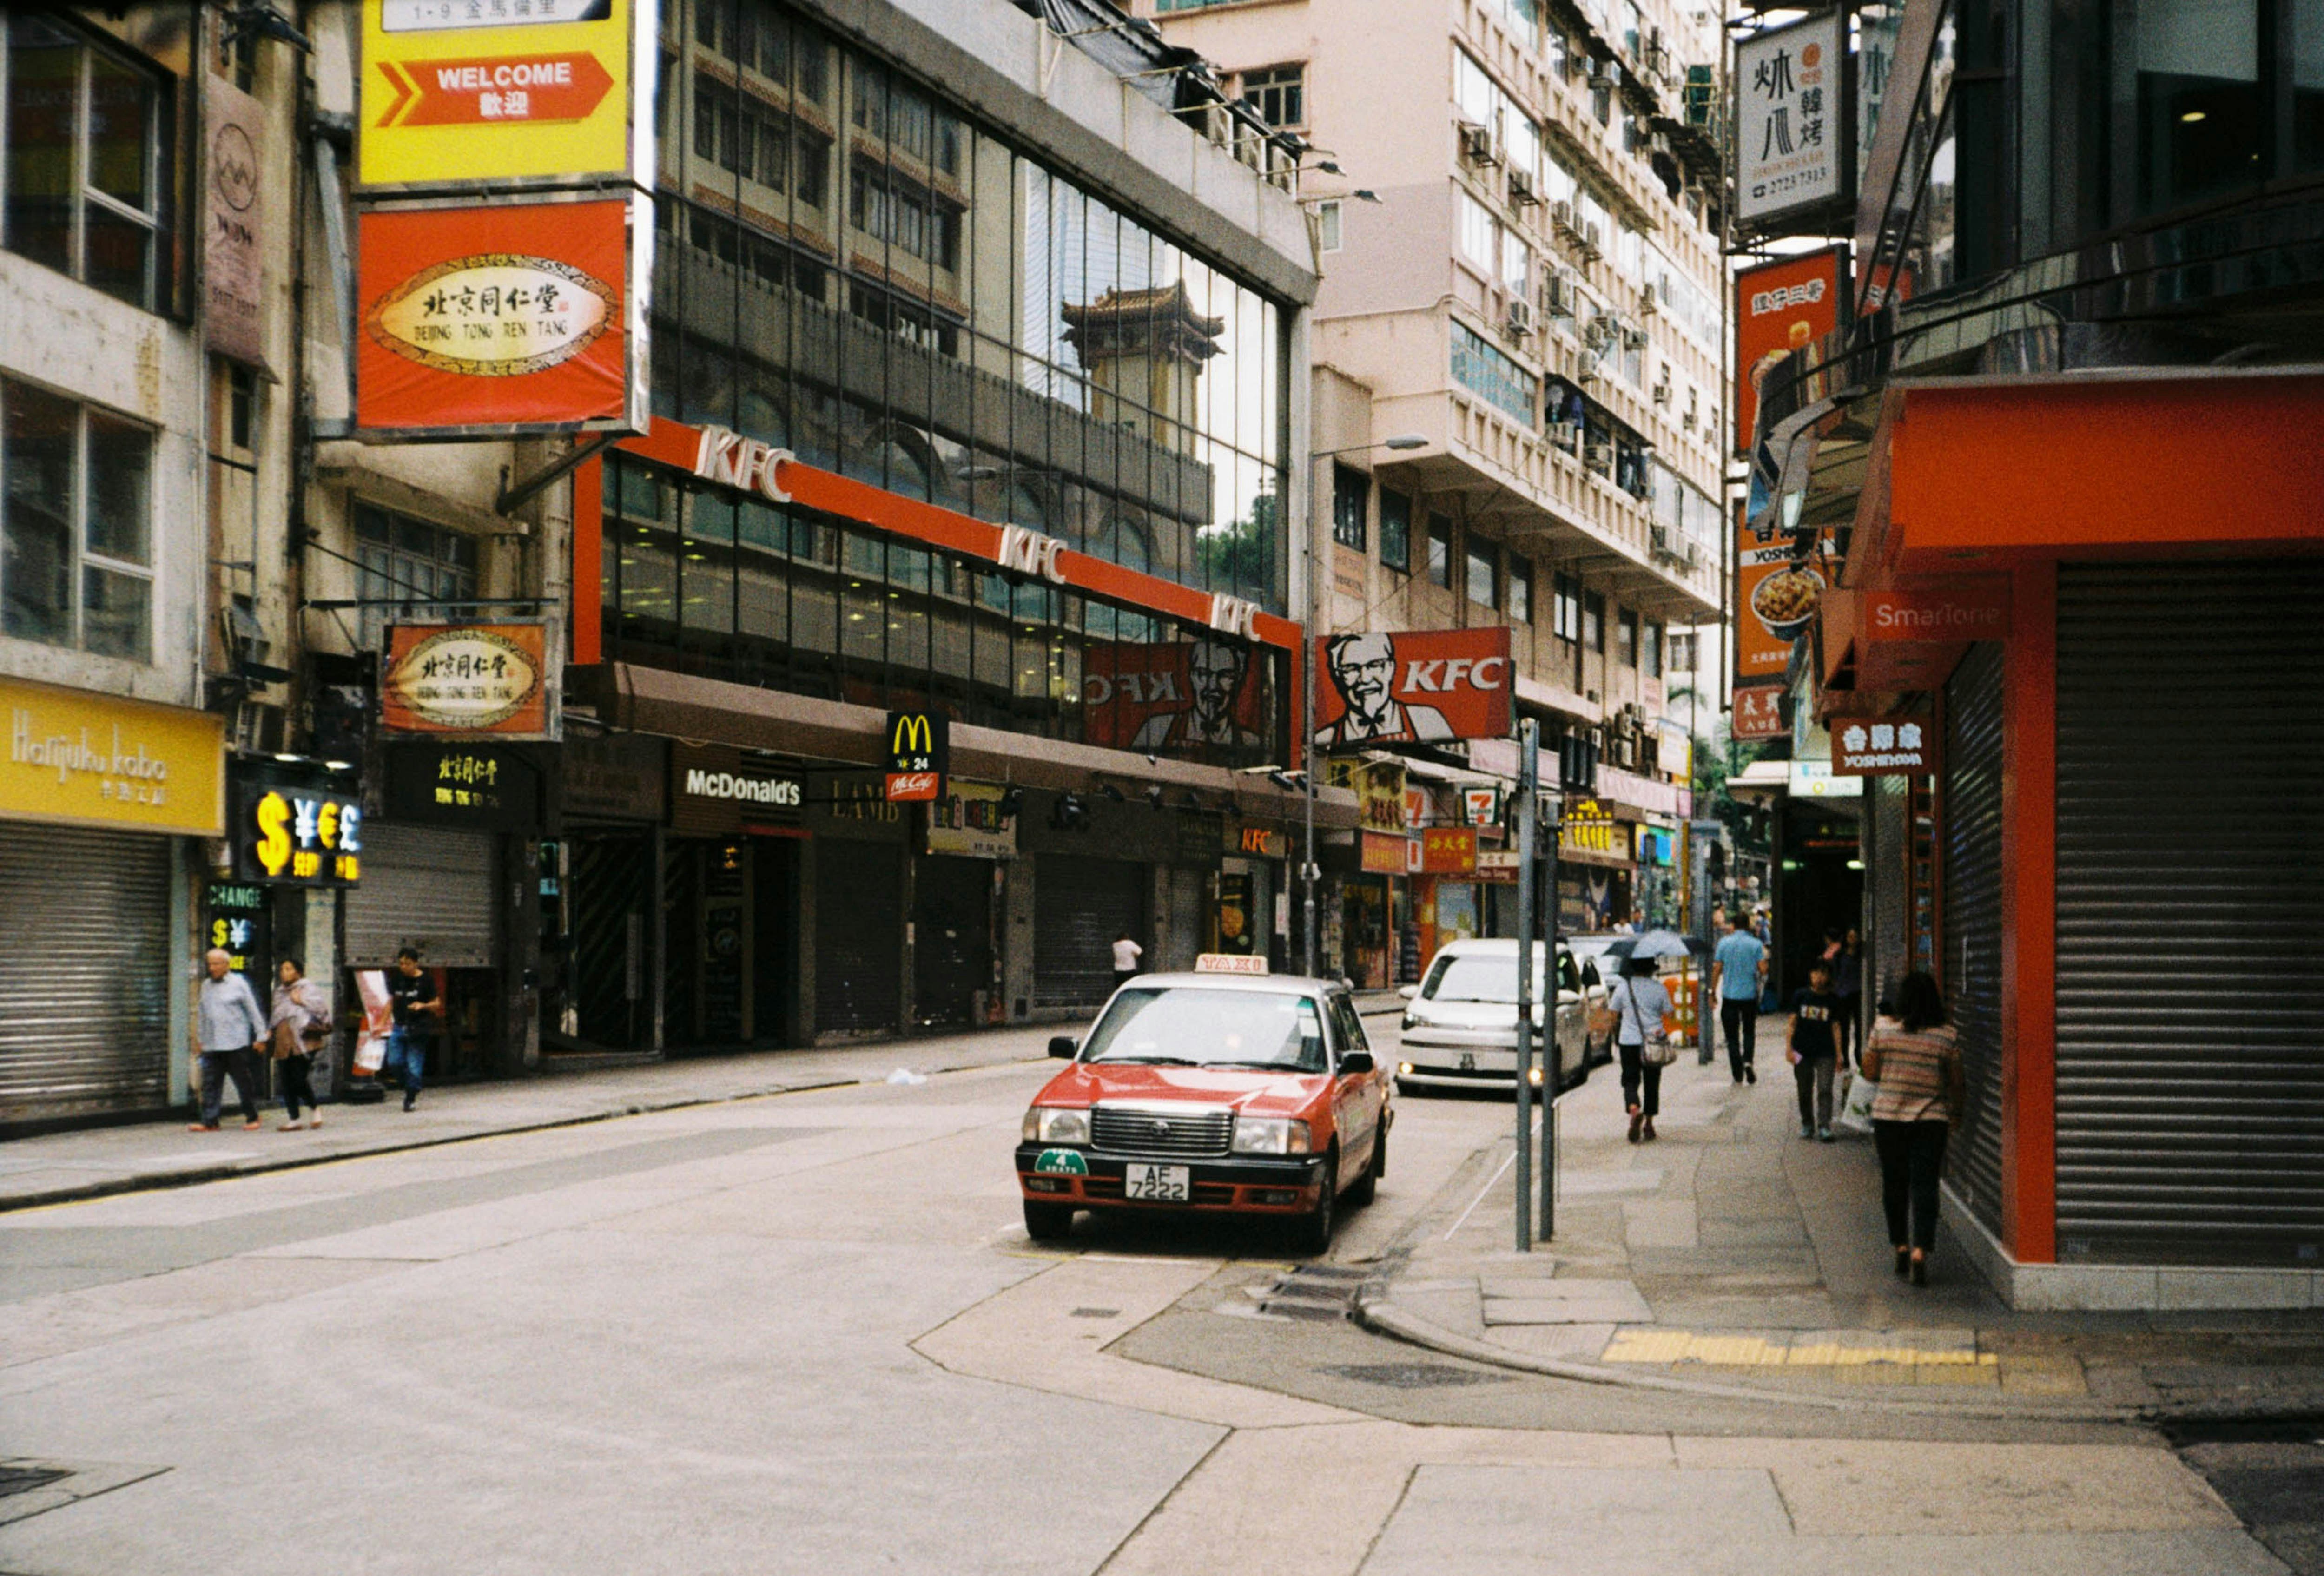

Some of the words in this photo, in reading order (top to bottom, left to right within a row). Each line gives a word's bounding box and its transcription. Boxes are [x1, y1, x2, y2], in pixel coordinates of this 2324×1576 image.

[437, 62, 571, 90] WELCOME
[423, 284, 559, 318] 北京同仁堂
[415, 323, 451, 342] BEIJING
[463, 323, 493, 339] TONG
[503, 322, 527, 338] REN
[537, 320, 568, 336] TANG
[693, 423, 795, 502] KFC
[998, 523, 1068, 584] KFC
[1209, 591, 1261, 642] KFC
[422, 653, 507, 679] 北京同仁堂
[1400, 657, 1503, 692] KFC
[914, 757, 929, 771] 24
[687, 768, 800, 806] McDonald's
[1471, 794, 1491, 824] 7
[1241, 828, 1272, 853] KFC
[209, 885, 262, 908] CHANGE
[1202, 956, 1261, 971] TAXI
[1056, 1154, 1067, 1167] 4
[1130, 1180, 1184, 1200] 7222
